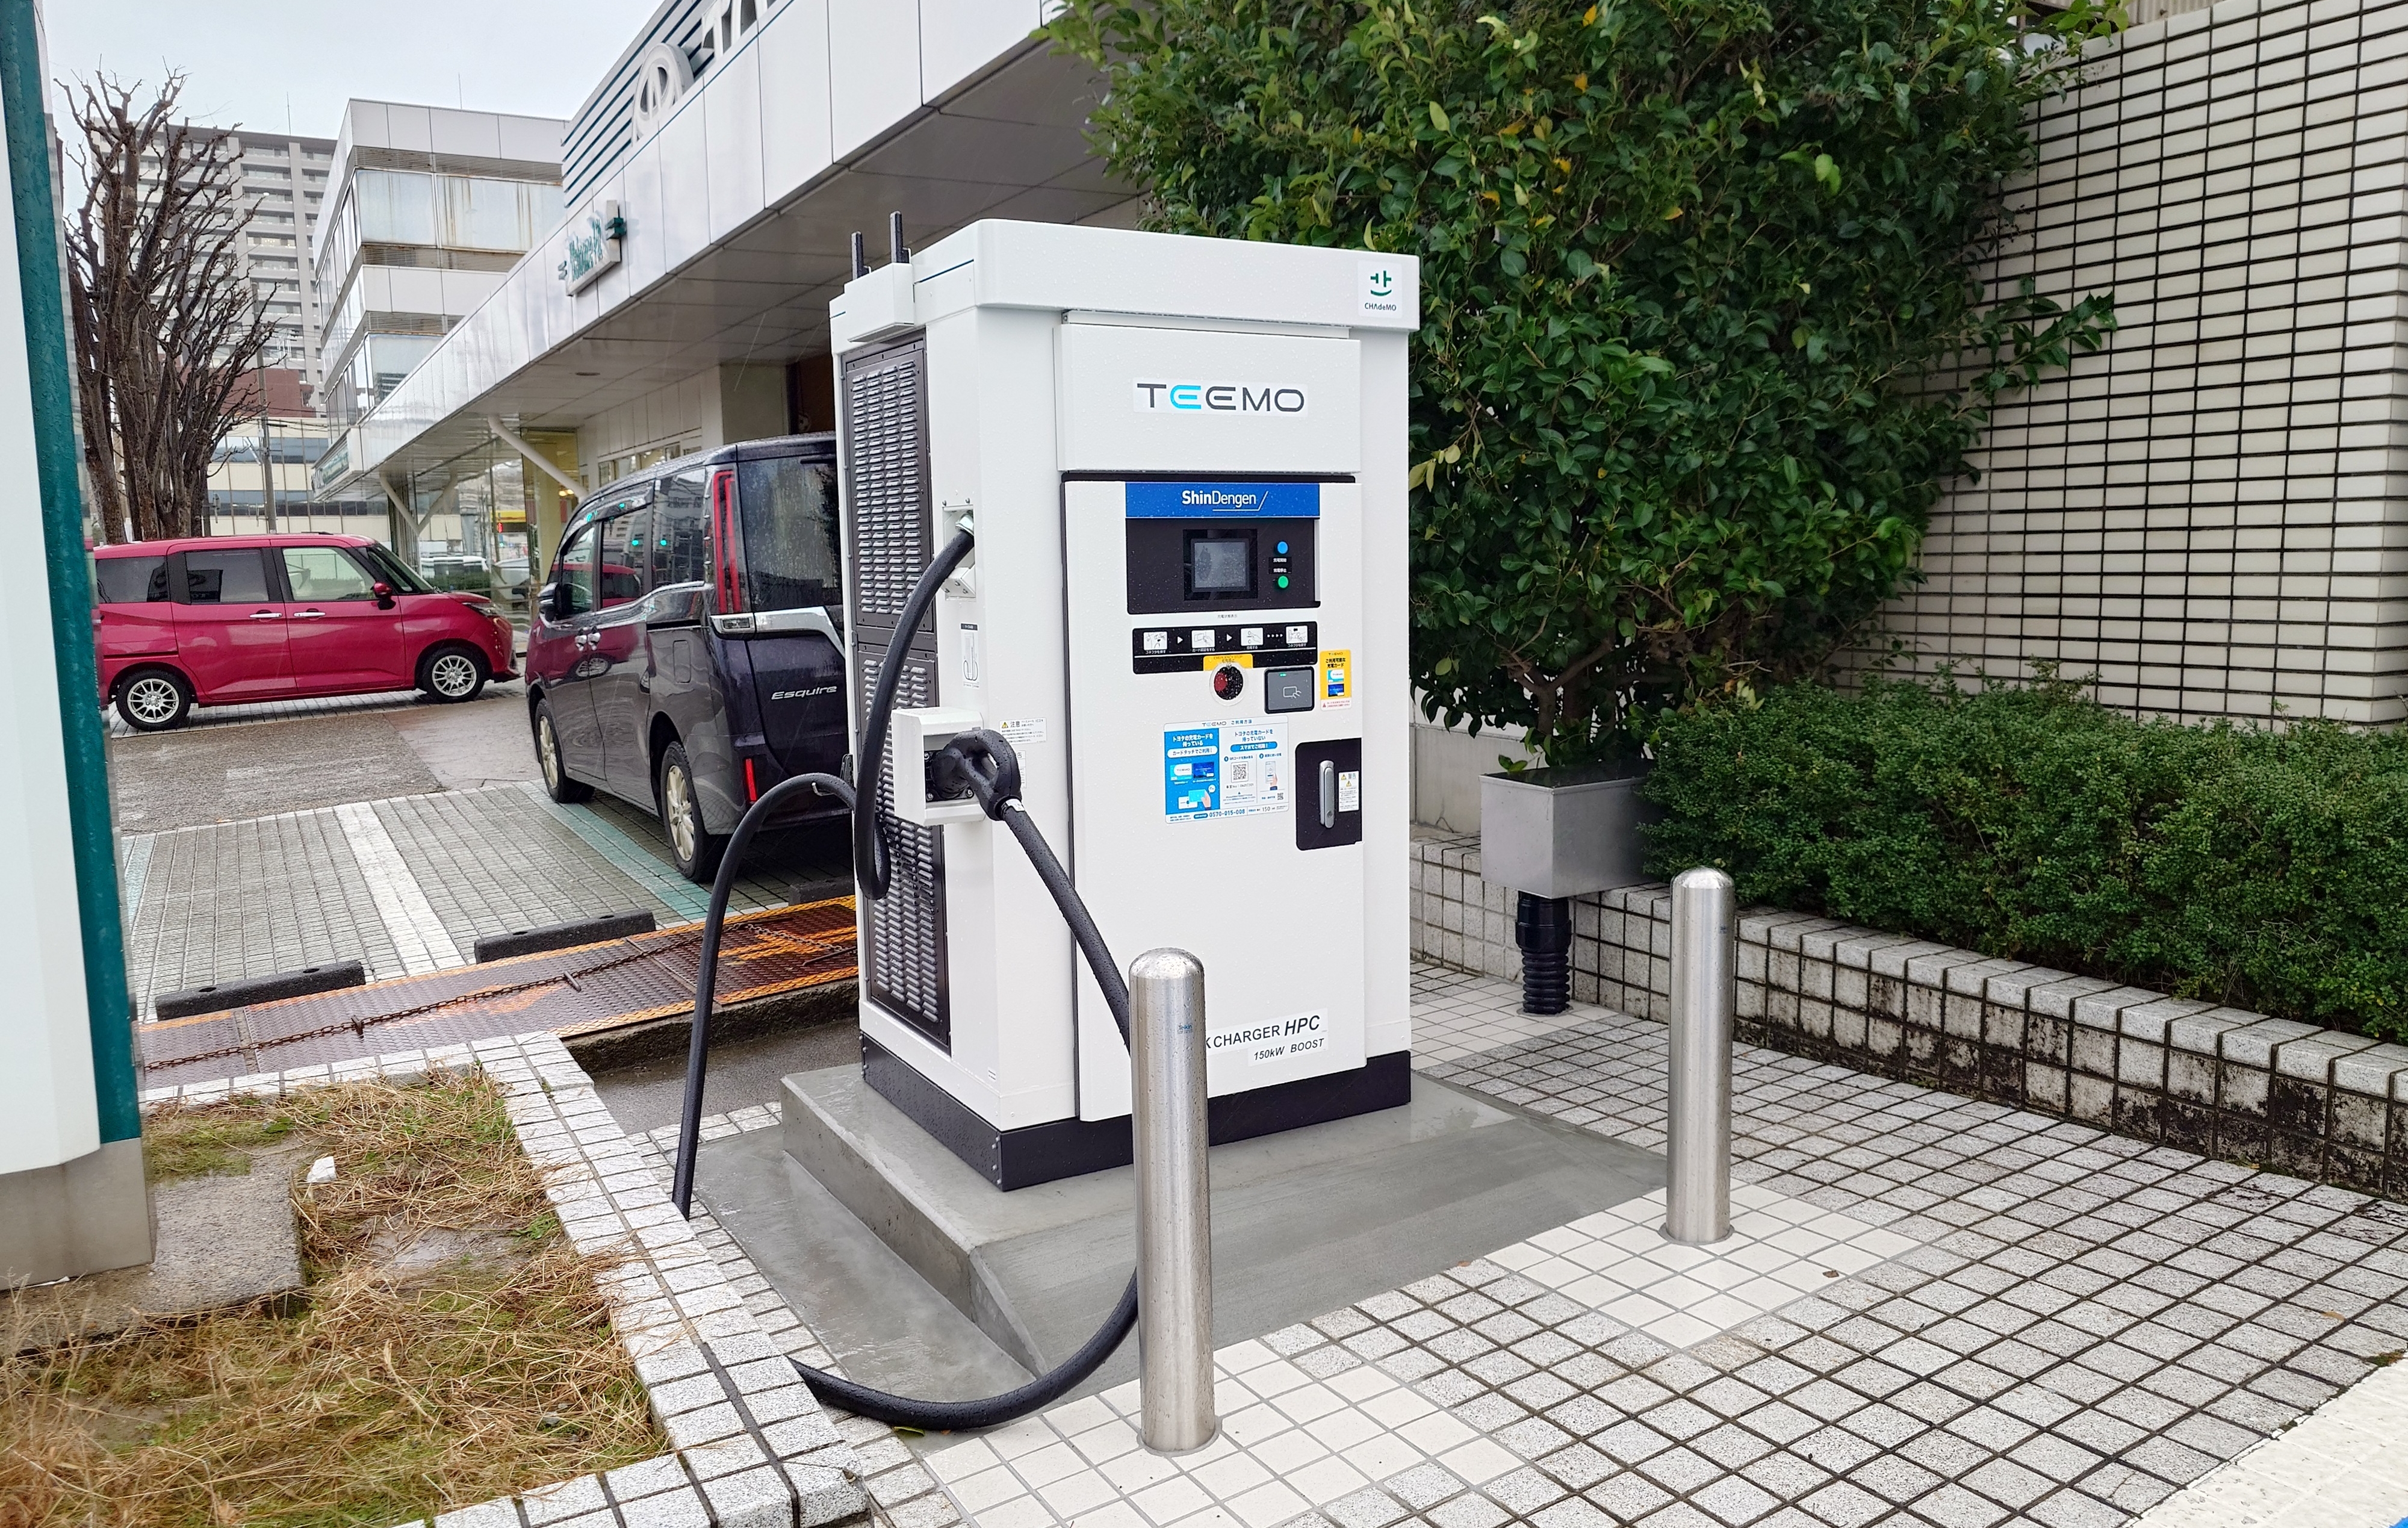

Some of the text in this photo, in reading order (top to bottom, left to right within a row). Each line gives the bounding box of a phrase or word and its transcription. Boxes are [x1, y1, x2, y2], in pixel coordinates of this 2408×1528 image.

[1364, 302, 1397, 311] CHAdeMO
[1137, 383, 1305, 412] TEEMO
[1182, 490, 1256, 508] ShinDengen
[772, 686, 837, 700] Esquire
[1173, 733, 1213, 742] トヨタの充電カードを
[1209, 809, 1245, 818] 0570-015-008
[1214, 1025, 1280, 1048] CHARGER
[1285, 1015, 1320, 1036] HPC
[1254, 1038, 1324, 1061] 150kW BOOST
